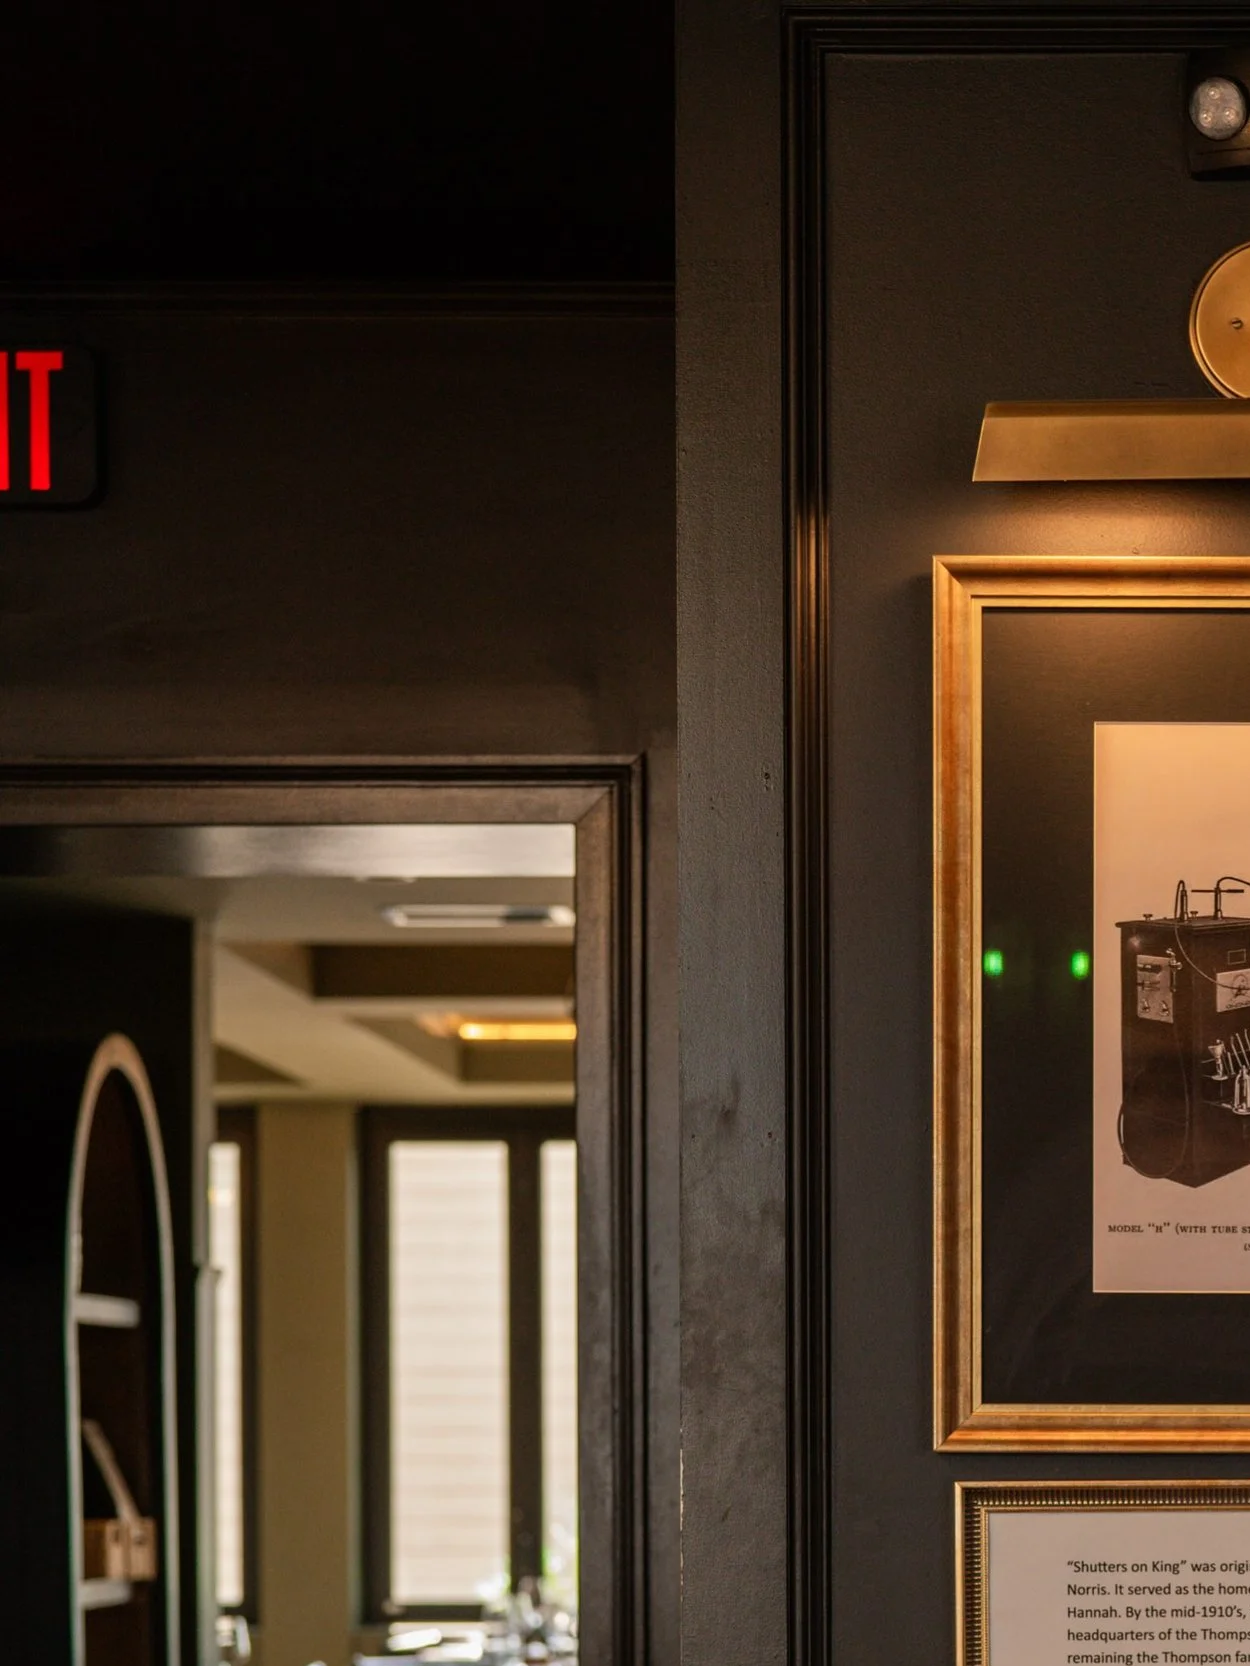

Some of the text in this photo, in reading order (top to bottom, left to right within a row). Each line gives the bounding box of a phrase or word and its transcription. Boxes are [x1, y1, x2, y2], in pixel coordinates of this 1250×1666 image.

[1107, 1224, 1144, 1234] MODEL
[1174, 1222, 1207, 1236] (WITH
[1210, 1225, 1239, 1235] TUBE
[1066, 1560, 1129, 1574] “Shutters
[1130, 1562, 1148, 1573] on
[1151, 1559, 1188, 1576] King”
[1190, 1562, 1217, 1573] was
[1066, 1583, 1111, 1597] Norris.
[1114, 1583, 1125, 1596] It
[1127, 1582, 1172, 1596] served
[1174, 1585, 1190, 1596] as
[1191, 1582, 1216, 1596] the
[1067, 1605, 1122, 1619] Hannah.
[1125, 1605, 1142, 1621] By
[1144, 1604, 1168, 1619] the
[1170, 1604, 1247, 1620] mid-1910’s,
[1067, 1628, 1156, 1644] headquarters
[1157, 1627, 1173, 1641] of
[1174, 1627, 1198, 1641] the
[1067, 1651, 1134, 1666] remaining
[1135, 1650, 1160, 1664] the
[1161, 1650, 1232, 1666] Thompson
